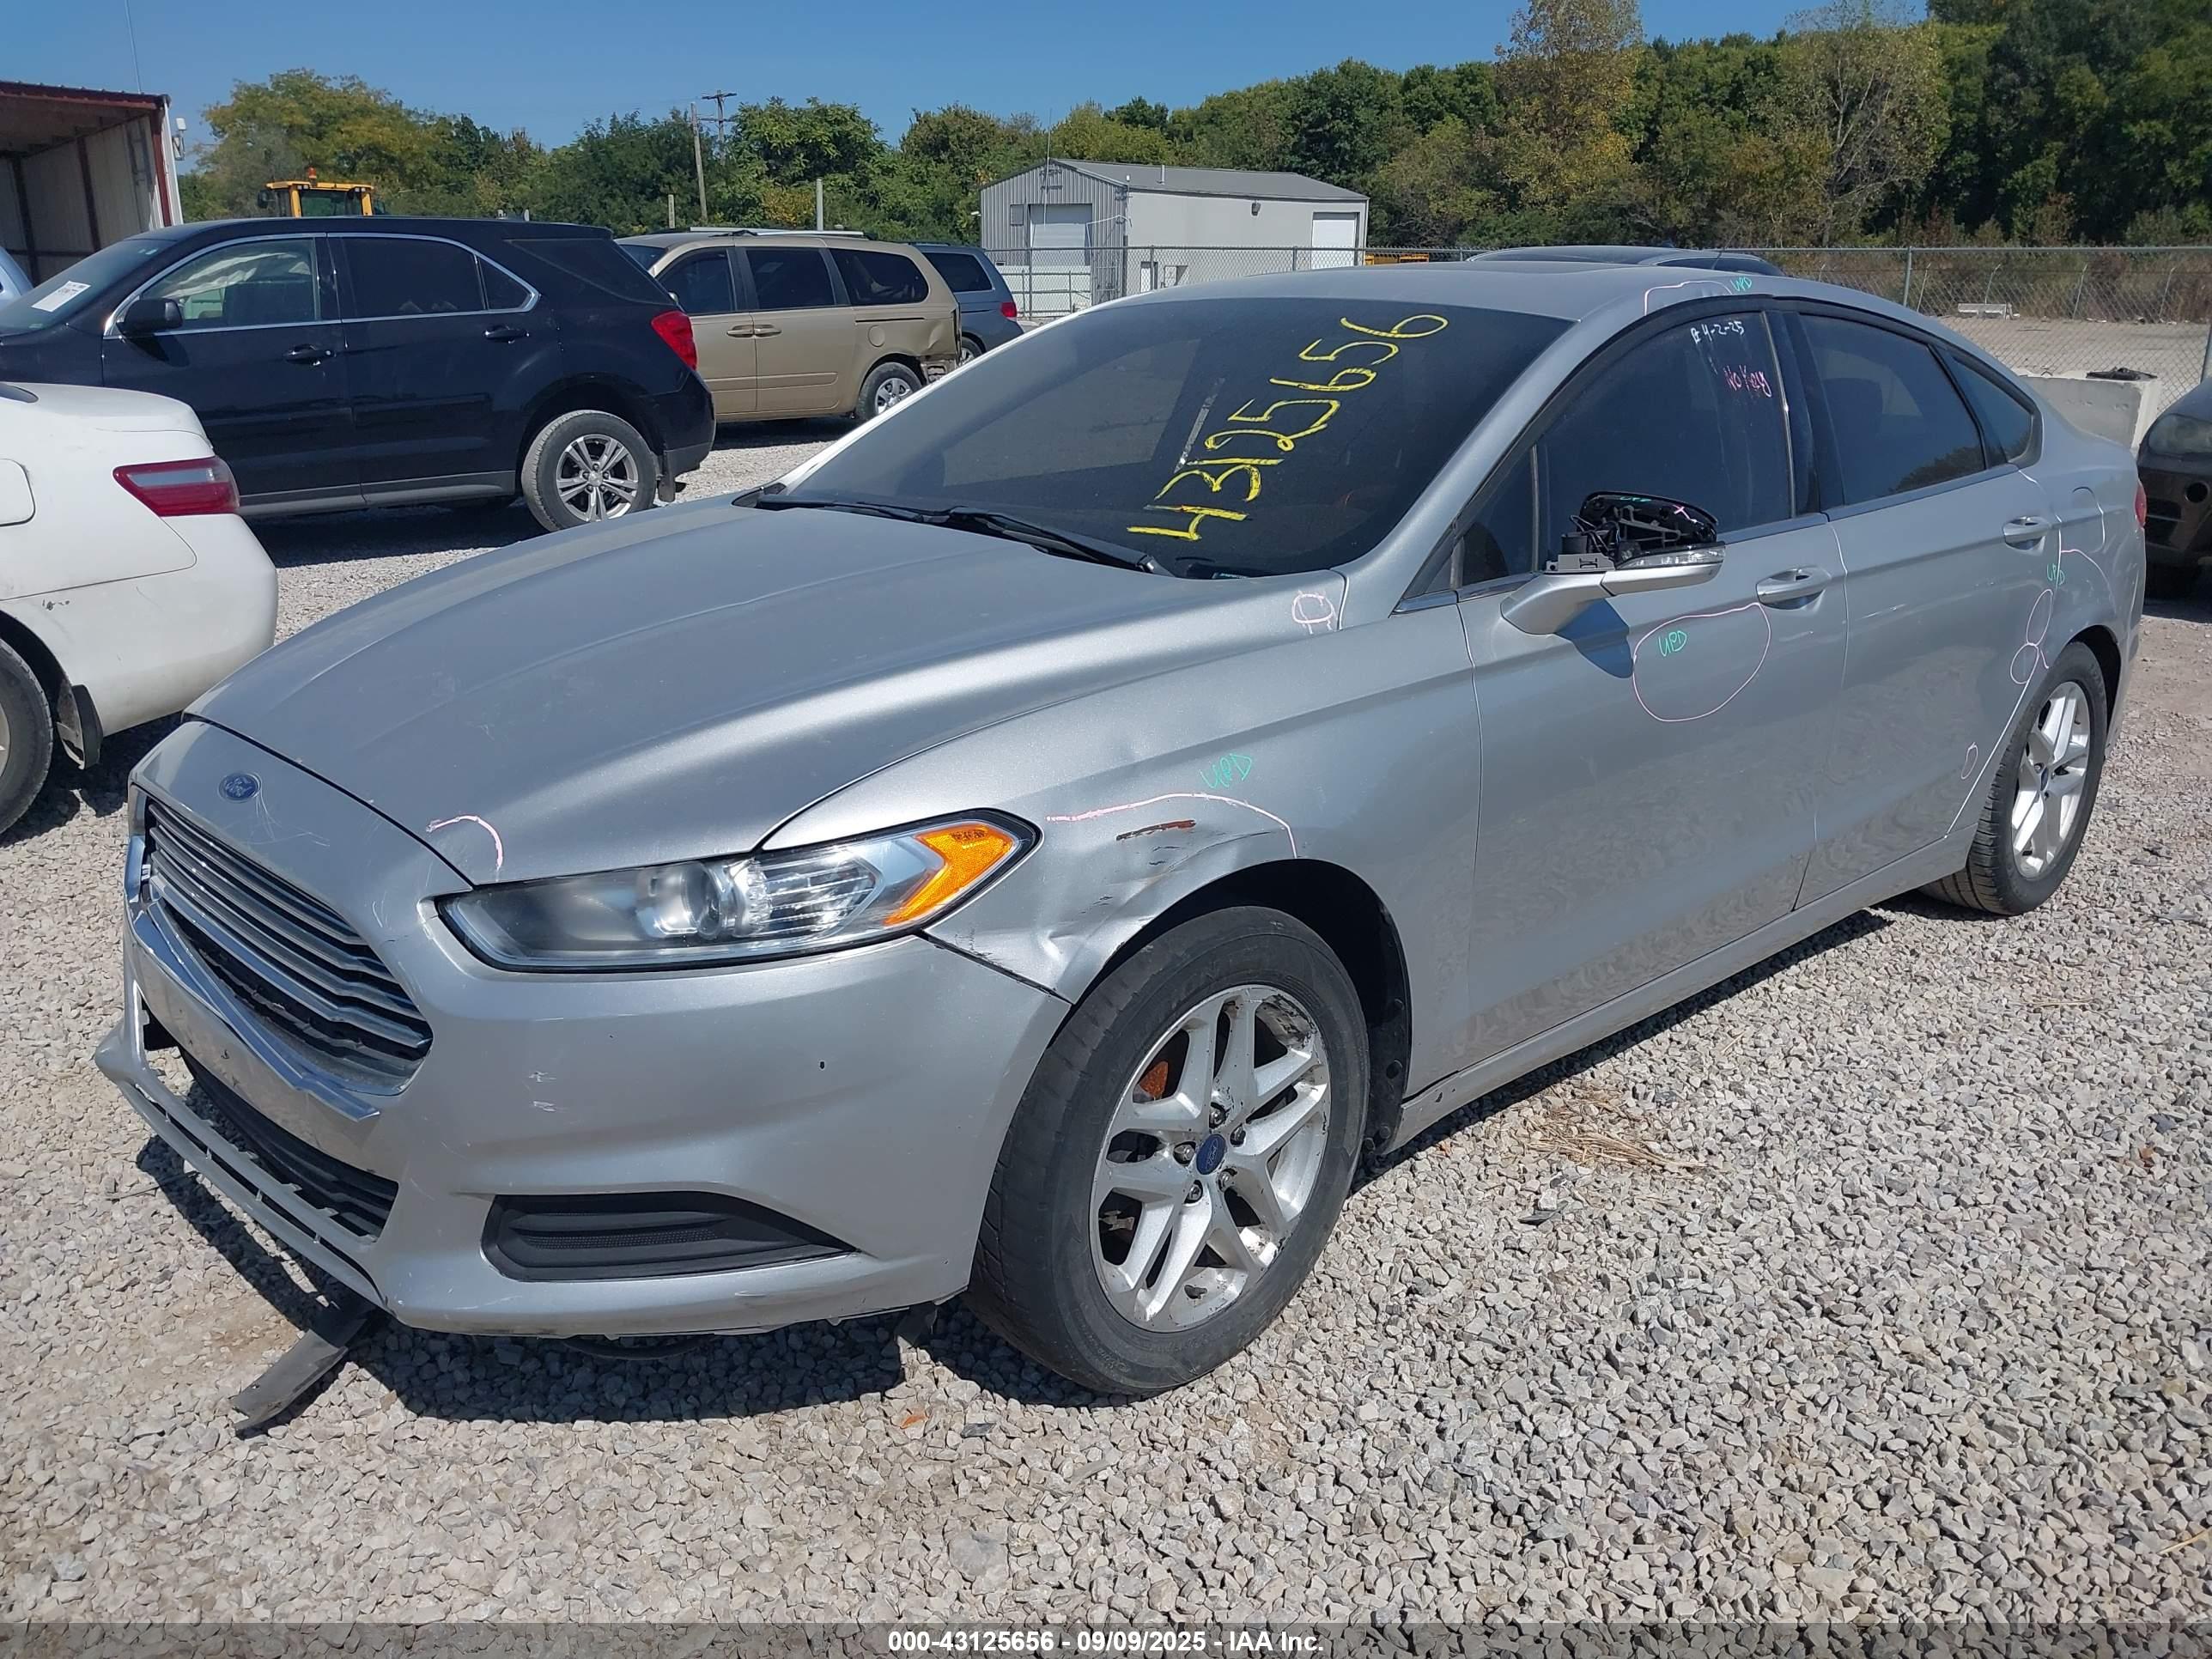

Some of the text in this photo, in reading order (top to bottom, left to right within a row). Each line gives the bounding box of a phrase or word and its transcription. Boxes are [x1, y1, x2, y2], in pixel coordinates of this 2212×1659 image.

[1738, 364, 1772, 398] Key
[1126, 313, 1449, 541] 43125656
[1658, 629, 1688, 657] UPD
